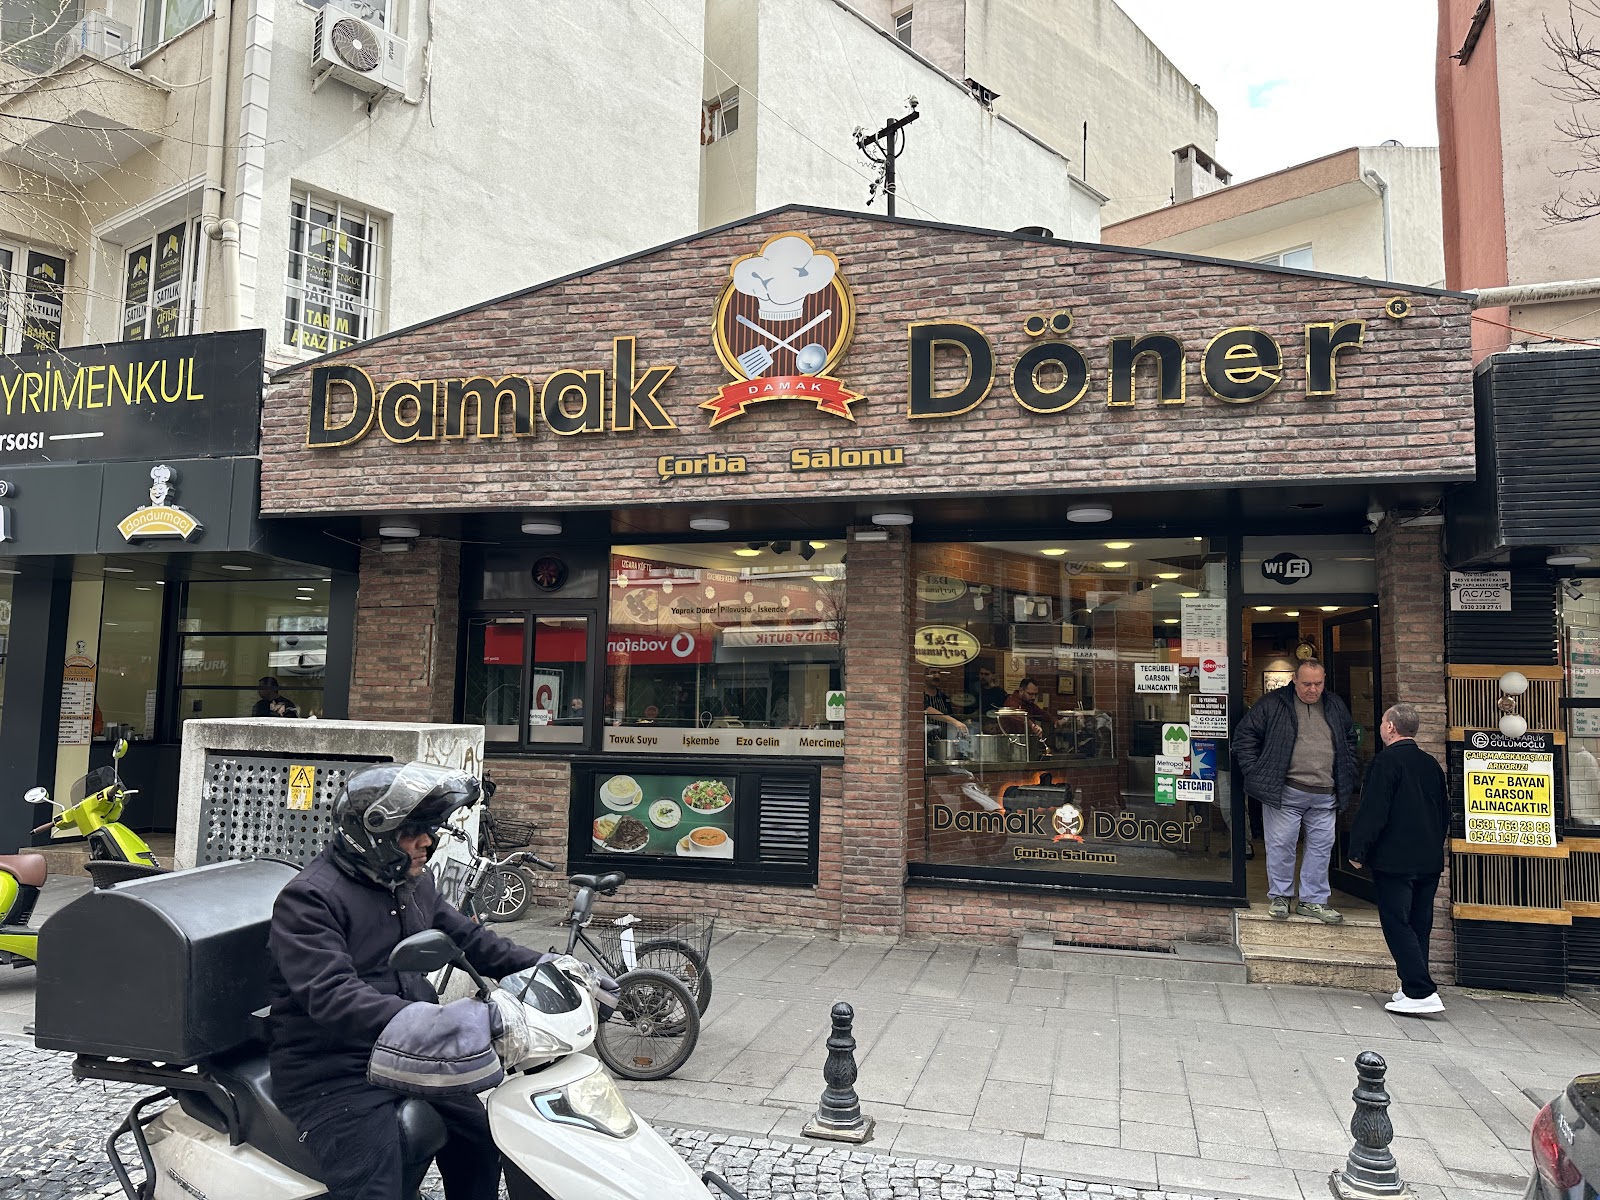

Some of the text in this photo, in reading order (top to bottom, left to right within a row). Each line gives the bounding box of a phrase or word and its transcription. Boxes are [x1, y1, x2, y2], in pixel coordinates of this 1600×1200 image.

[306, 309, 349, 334] TARM
[306, 335, 679, 448] Damak
[907, 309, 1366, 419] Döner
[748, 382, 823, 394] DAMAK
[656, 447, 904, 483] Çorba Salonu
[126, 510, 190, 532] dondurmacı
[671, 607, 695, 616] Yaprak
[696, 605, 717, 614] Döner
[609, 734, 845, 748] Tavuk Suyu İşkembe Ezo Gelin Mercimek
[1465, 751, 1500, 761] ÇALIŞMA
[1156, 760, 1184, 768] Metropol
[1177, 780, 1213, 792] SETCARD
[1473, 775, 1496, 785] BAY
[1507, 776, 1545, 788] BAYAN
[1485, 788, 1534, 800] GARSON
[1471, 800, 1549, 814] ALINACAKTIR
[932, 804, 1047, 836] Damak
[1093, 811, 1195, 844] Döner
[1469, 818, 1551, 833] 0531 763 28 88
[1469, 830, 1552, 845] 0541 197 49 39
[1013, 846, 1117, 864] Çorba Salonu
